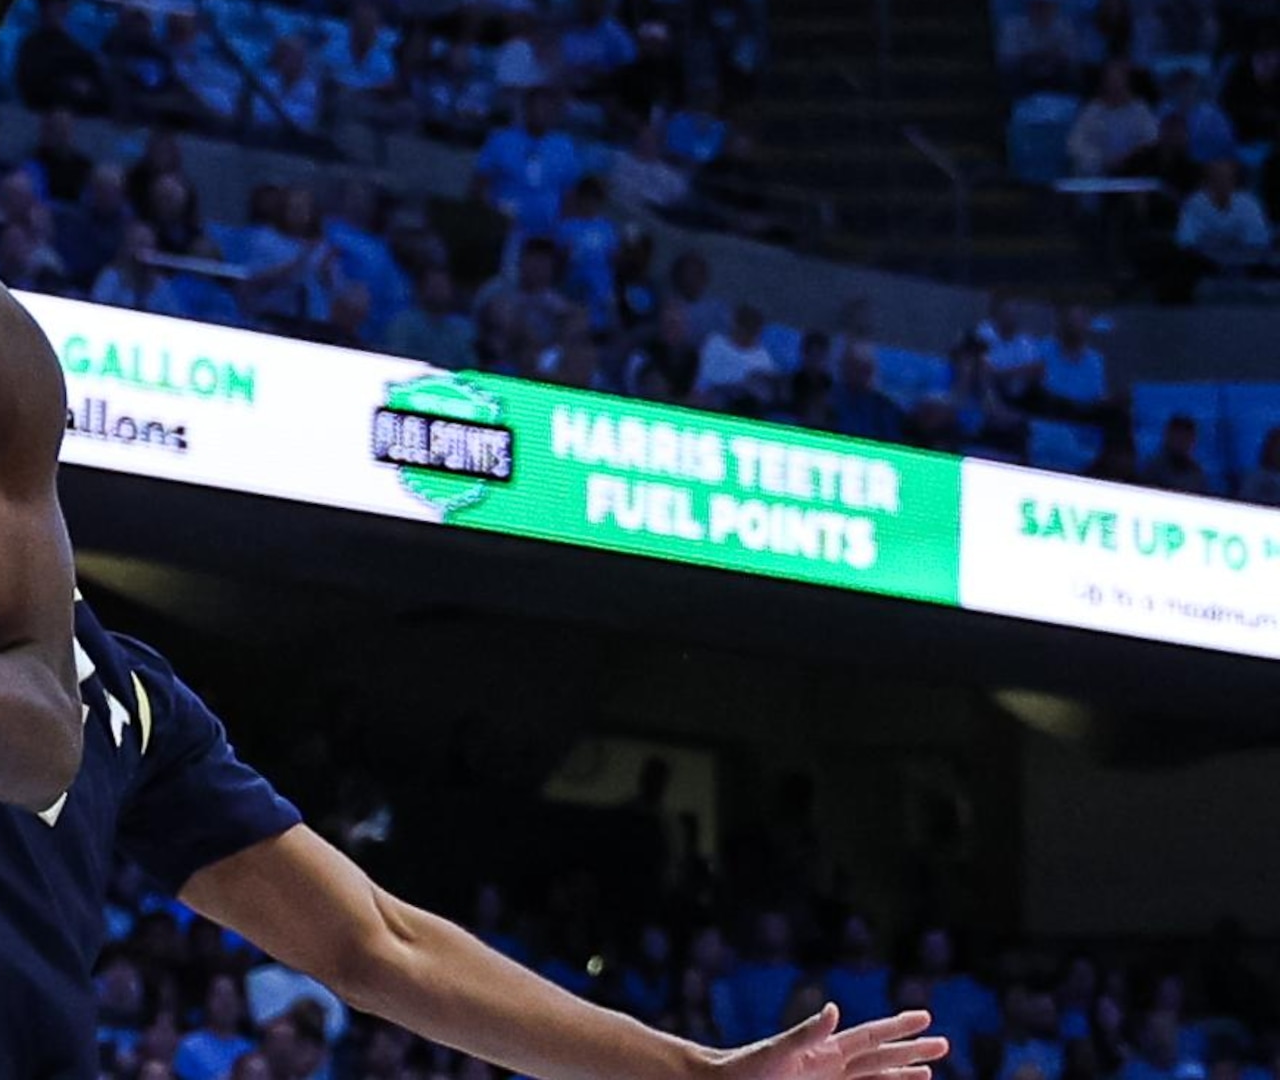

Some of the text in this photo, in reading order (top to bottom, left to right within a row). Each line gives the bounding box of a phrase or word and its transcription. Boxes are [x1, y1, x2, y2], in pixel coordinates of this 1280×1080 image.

[63, 333, 257, 405] GALLON
[551, 403, 899, 515] HARRIS TEETER
[586, 472, 877, 568] FUEL POINTS
[1020, 498, 1118, 551] SAVE
[1132, 517, 1186, 559] UP
[1197, 528, 1248, 570] TO
